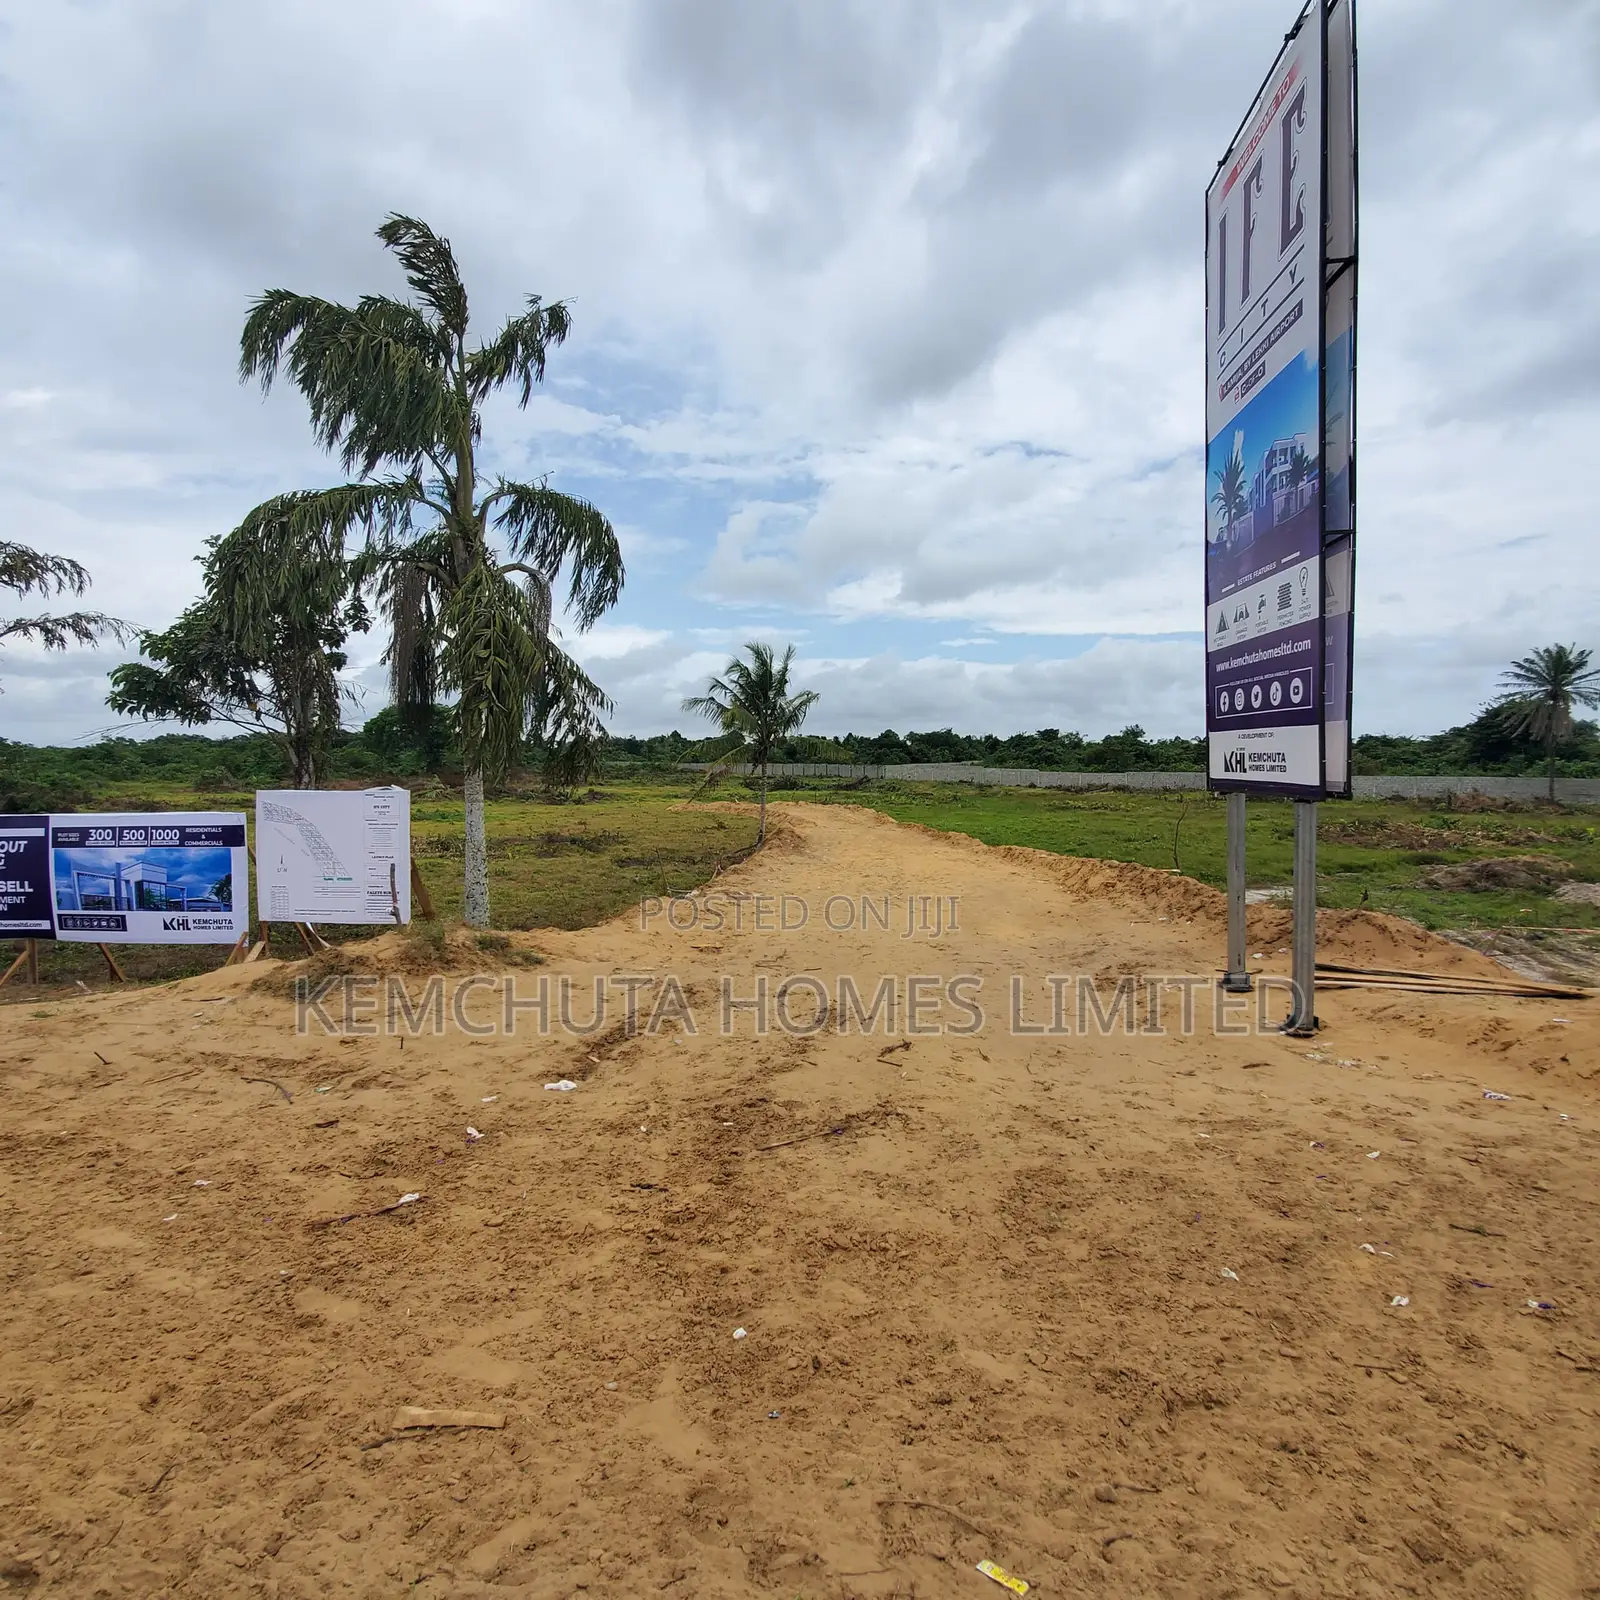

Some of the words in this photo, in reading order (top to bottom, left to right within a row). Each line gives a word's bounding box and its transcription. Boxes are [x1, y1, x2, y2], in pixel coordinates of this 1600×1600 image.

[1236, 98, 1277, 175] WELCOME
[1276, 77, 1290, 108] TO
[1217, 77, 1307, 340] IFE
[1269, 305, 1299, 345] AIRPORT
[1237, 573, 1253, 586] ESTATE
[1253, 561, 1277, 579] FEATURES
[1216, 639, 1311, 672] www.kemchutahomesltd.com
[1248, 752, 1286, 763] KEMCHUTA
[1248, 764, 1265, 772] HOMES
[1266, 765, 1287, 773] LIMITED
[89, 829, 112, 840] 300
[122, 829, 145, 840] 500
[151, 829, 179, 840] 1000
[0, 880, 34, 893] SELL
